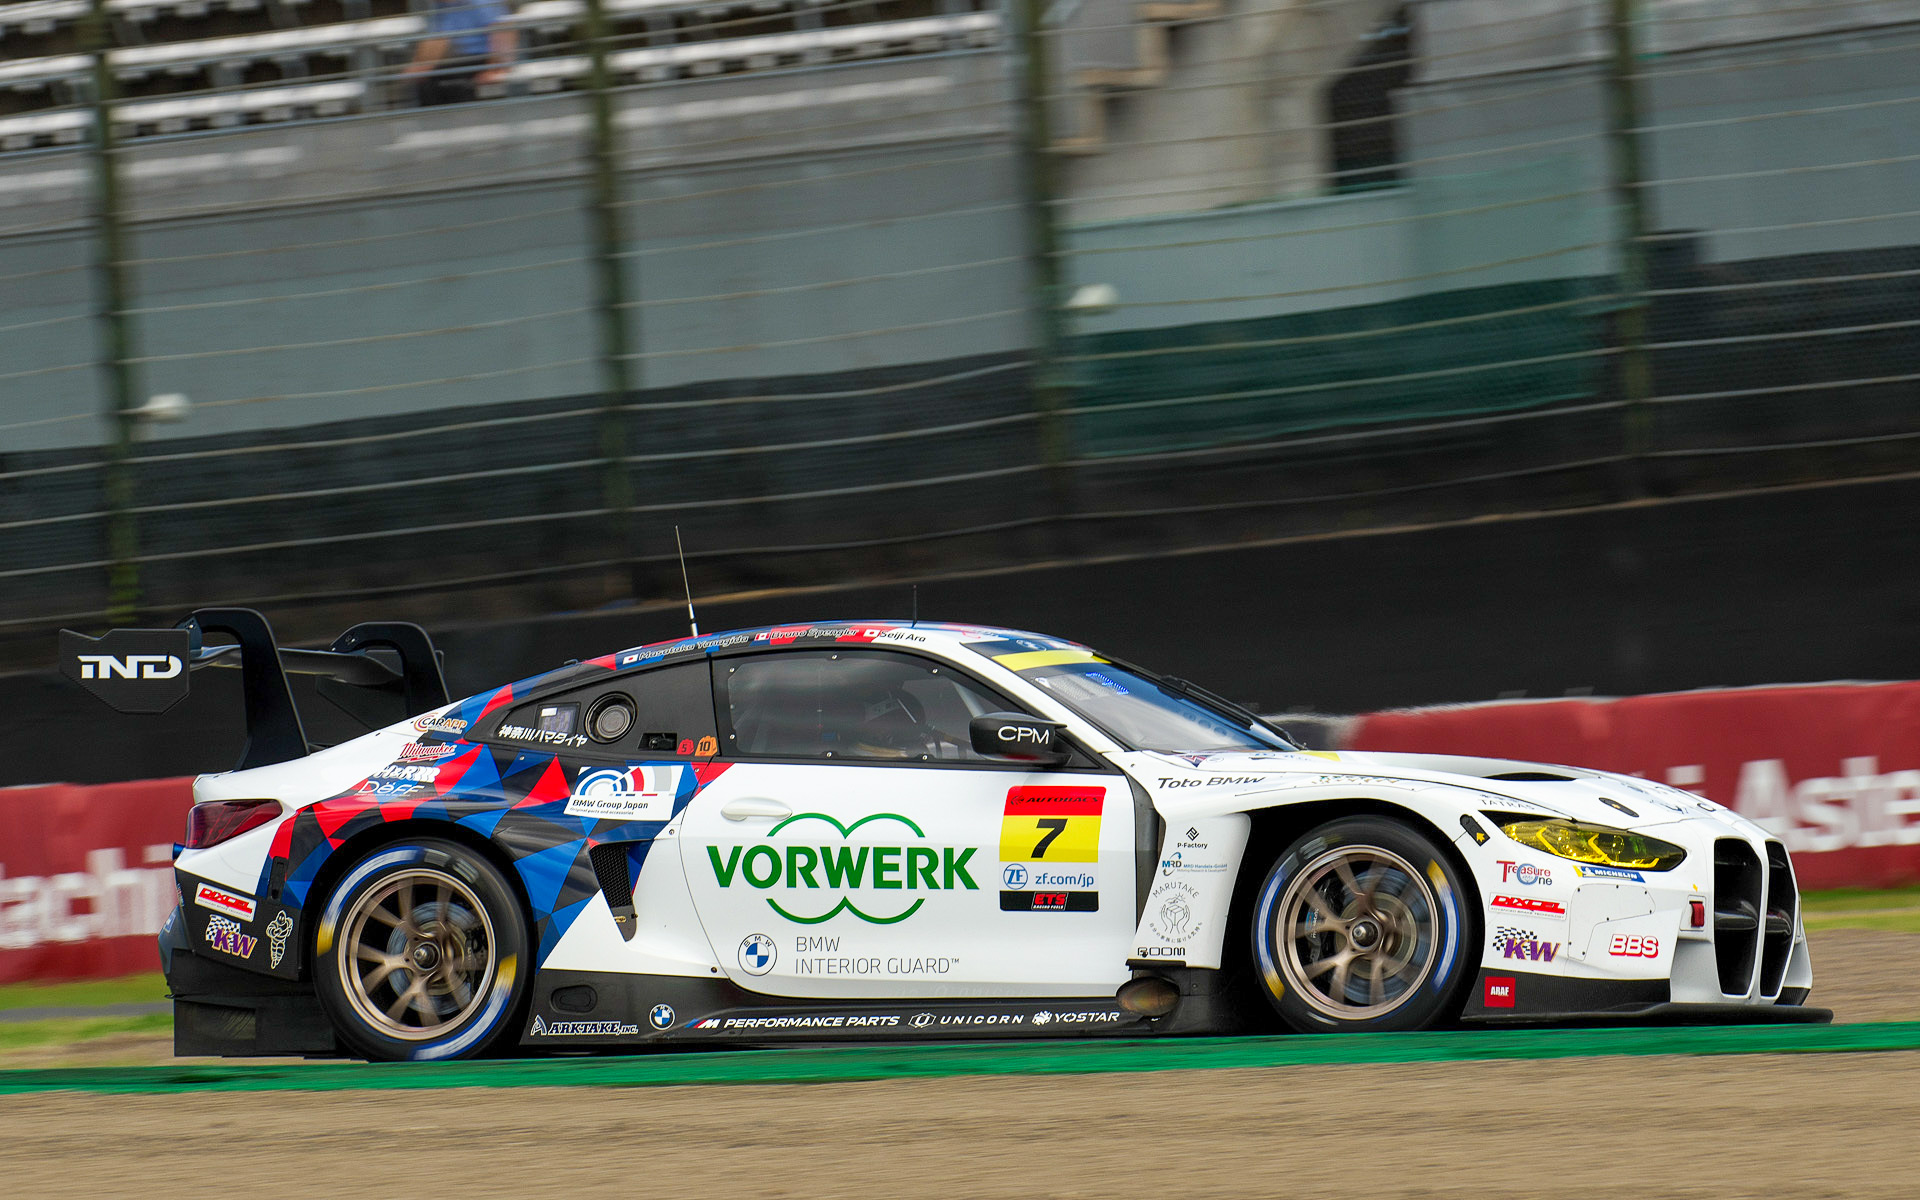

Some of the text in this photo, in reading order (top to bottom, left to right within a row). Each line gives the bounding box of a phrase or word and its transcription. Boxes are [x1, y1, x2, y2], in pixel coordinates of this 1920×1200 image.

[771, 628, 859, 639] Bruno Spengler
[880, 631, 926, 642] Seiji Ara
[498, 724, 588, 748] 神奈川ハマタイヤ
[997, 725, 1050, 744] CPM
[400, 742, 457, 758] Milwaukee
[682, 744, 688, 752] 5
[700, 741, 711, 752] 10
[1158, 776, 1266, 789] Toto BMW
[572, 799, 649, 810] BMW Group Japan
[1030, 818, 1068, 858] 7
[1177, 842, 1208, 850] P-Factory
[706, 845, 980, 890] VORWERK
[1162, 860, 1182, 868] MRD
[1496, 860, 1551, 882] Treasure
[1595, 869, 1638, 879] MICHELIN
[1006, 869, 1094, 888] ZF zf.com/jp
[1152, 881, 1200, 899] MARUTAKE
[1034, 893, 1067, 904] ETS
[1491, 895, 1566, 914] DIXCEL
[212, 928, 258, 959] KW
[743, 935, 772, 948] BMW
[796, 936, 840, 952] BMW
[1609, 934, 1659, 958] BBS
[1503, 937, 1561, 962] KW
[795, 958, 881, 974] INTERIOR
[1490, 986, 1509, 996] ARAF
[724, 1016, 843, 1028] PERFORMANCE
[846, 1015, 900, 1027] PARTS
[940, 1014, 1025, 1024] UNICORN
[1053, 1012, 1120, 1023] YOSTAR
